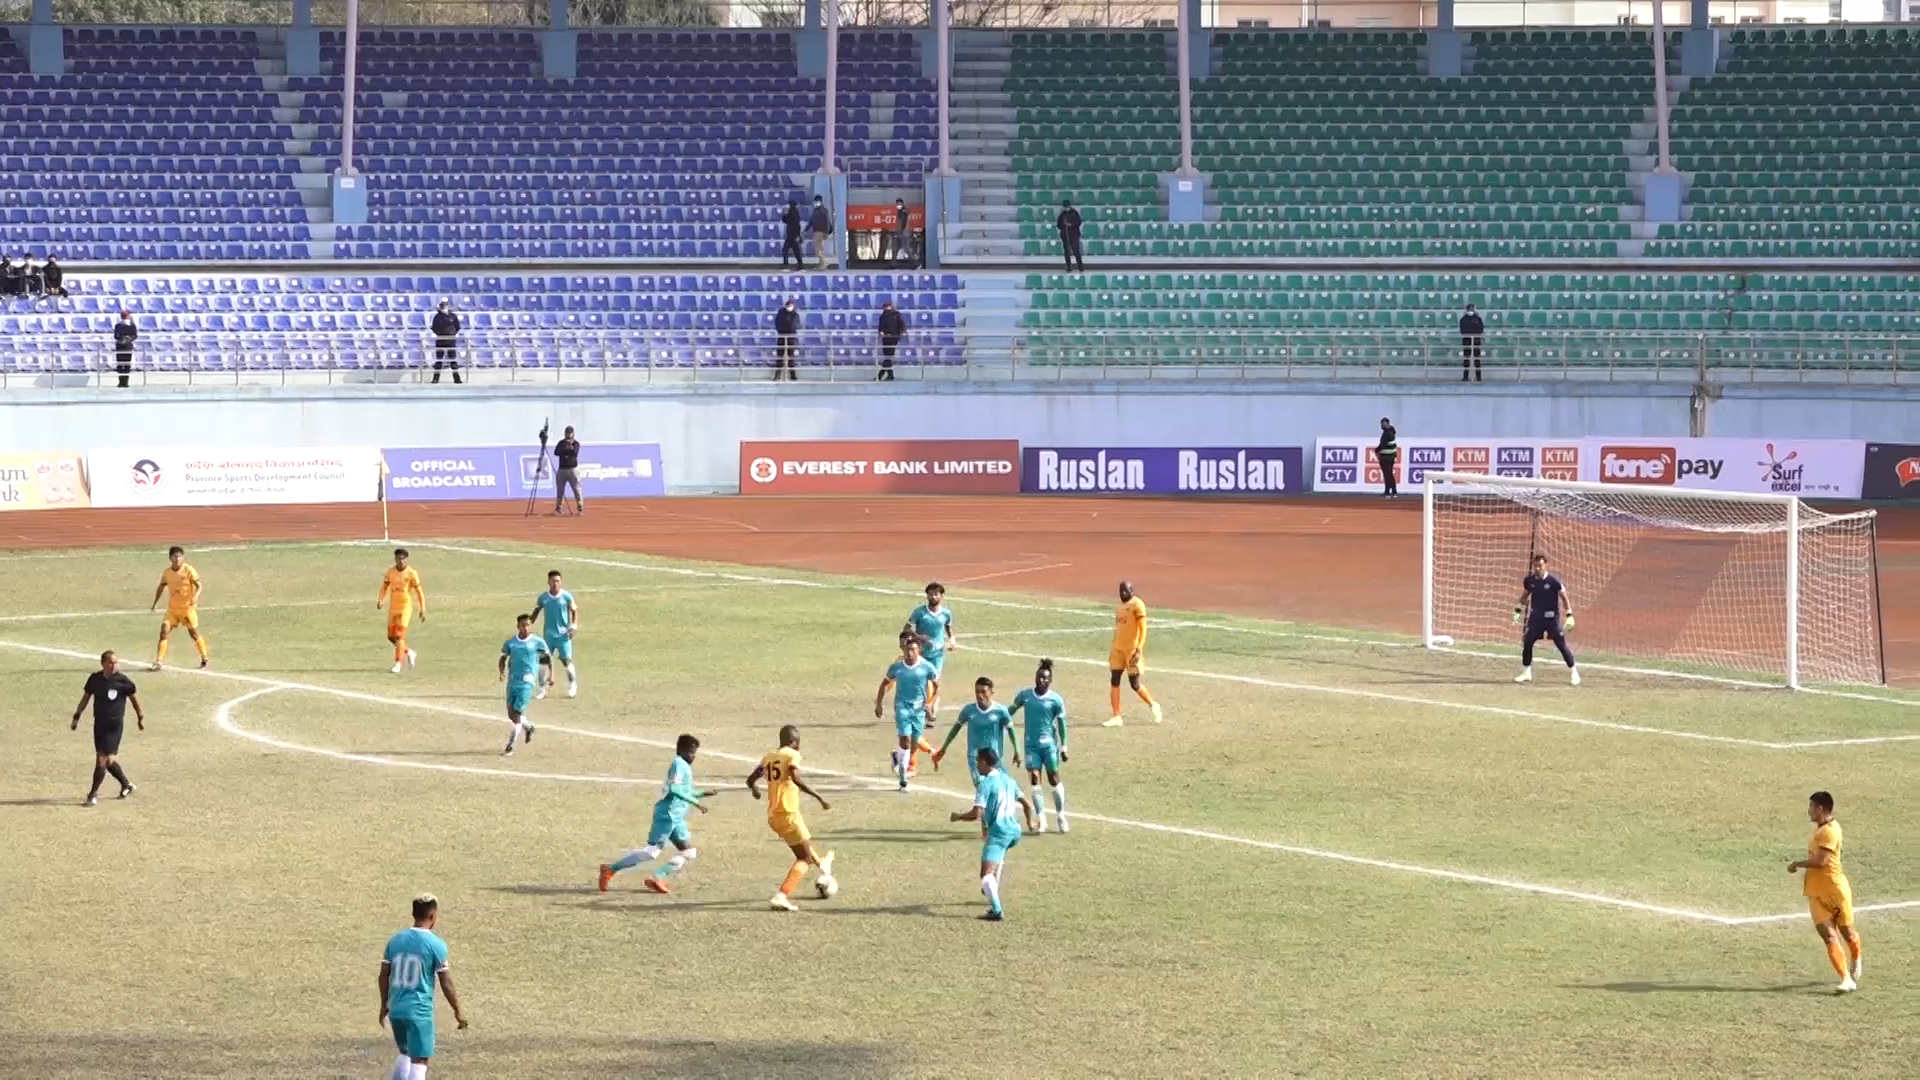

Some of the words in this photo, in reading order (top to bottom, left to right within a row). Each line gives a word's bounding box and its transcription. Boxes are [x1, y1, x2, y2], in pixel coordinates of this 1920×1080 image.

[1325, 449, 1354, 461] KTM
[1412, 450, 1442, 462] KTM
[1457, 450, 1486, 462] KTM
[1501, 450, 1530, 462] KTM
[1545, 450, 1575, 462] KTM
[411, 460, 476, 472] OFFICIAL
[783, 460, 867, 475] EVEREST
[874, 460, 928, 475] BANK
[934, 460, 1013, 475] LIMITED
[1039, 449, 1145, 490] Ruslan
[1178, 449, 1285, 490] Ruslan
[1603, 453, 1665, 478] fone
[1677, 459, 1724, 480] pay
[1772, 463, 1804, 481] Surf
[186, 473, 222, 482] Province
[225, 473, 252, 483] Sports
[254, 472, 311, 482] Development
[314, 472, 345, 481] Council
[392, 474, 497, 488] BROADCASTER
[1324, 468, 1353, 481] CTY
[1545, 469, 1573, 482] CTY
[1771, 482, 1802, 492] excel
[767, 760, 782, 782] 15
[392, 952, 421, 989] 10
